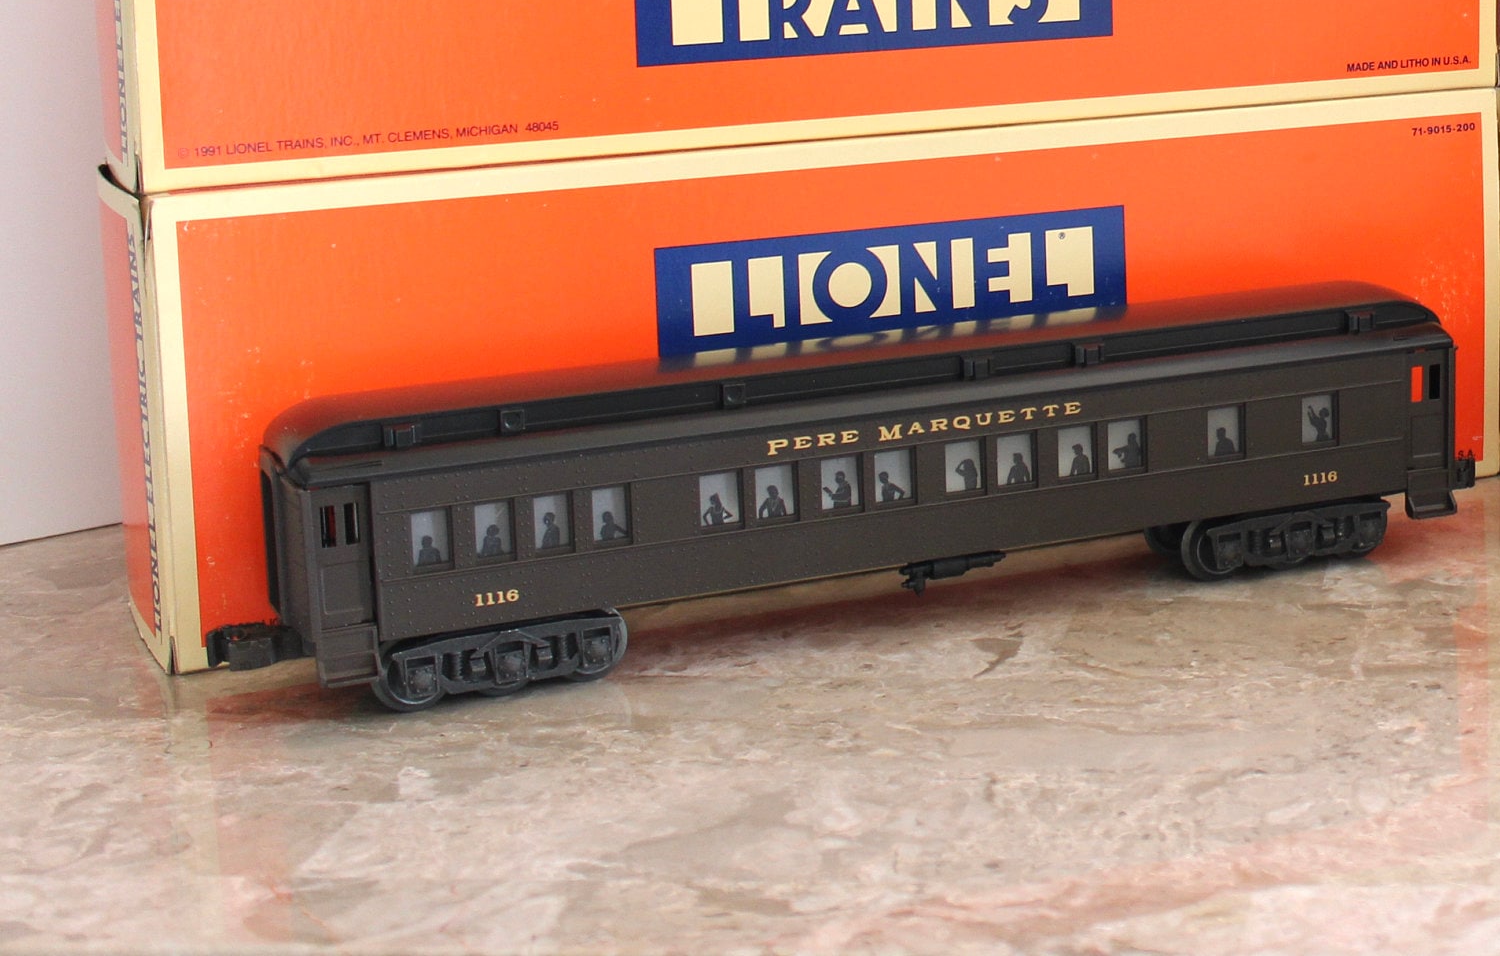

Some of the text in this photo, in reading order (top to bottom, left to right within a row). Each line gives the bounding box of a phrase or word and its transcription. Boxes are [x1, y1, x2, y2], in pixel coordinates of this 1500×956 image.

[1346, 55, 1471, 72] MADE AND LITHO IN U.S.A.
[1411, 122, 1476, 136] 71-9015-200
[195, 146, 221, 157] 1991
[226, 141, 272, 155] LIONEL
[277, 137, 327, 150] TRAINS,
[363, 133, 384, 144] MT.
[388, 128, 452, 143] CLEMENS,
[456, 123, 518, 138] MICHIGAN
[525, 121, 559, 132] 48045
[711, 228, 1082, 336] LIONEL
[767, 401, 1082, 458] PERE MARQUETTE
[1303, 471, 1338, 486] 1116
[474, 589, 520, 607] 1116
